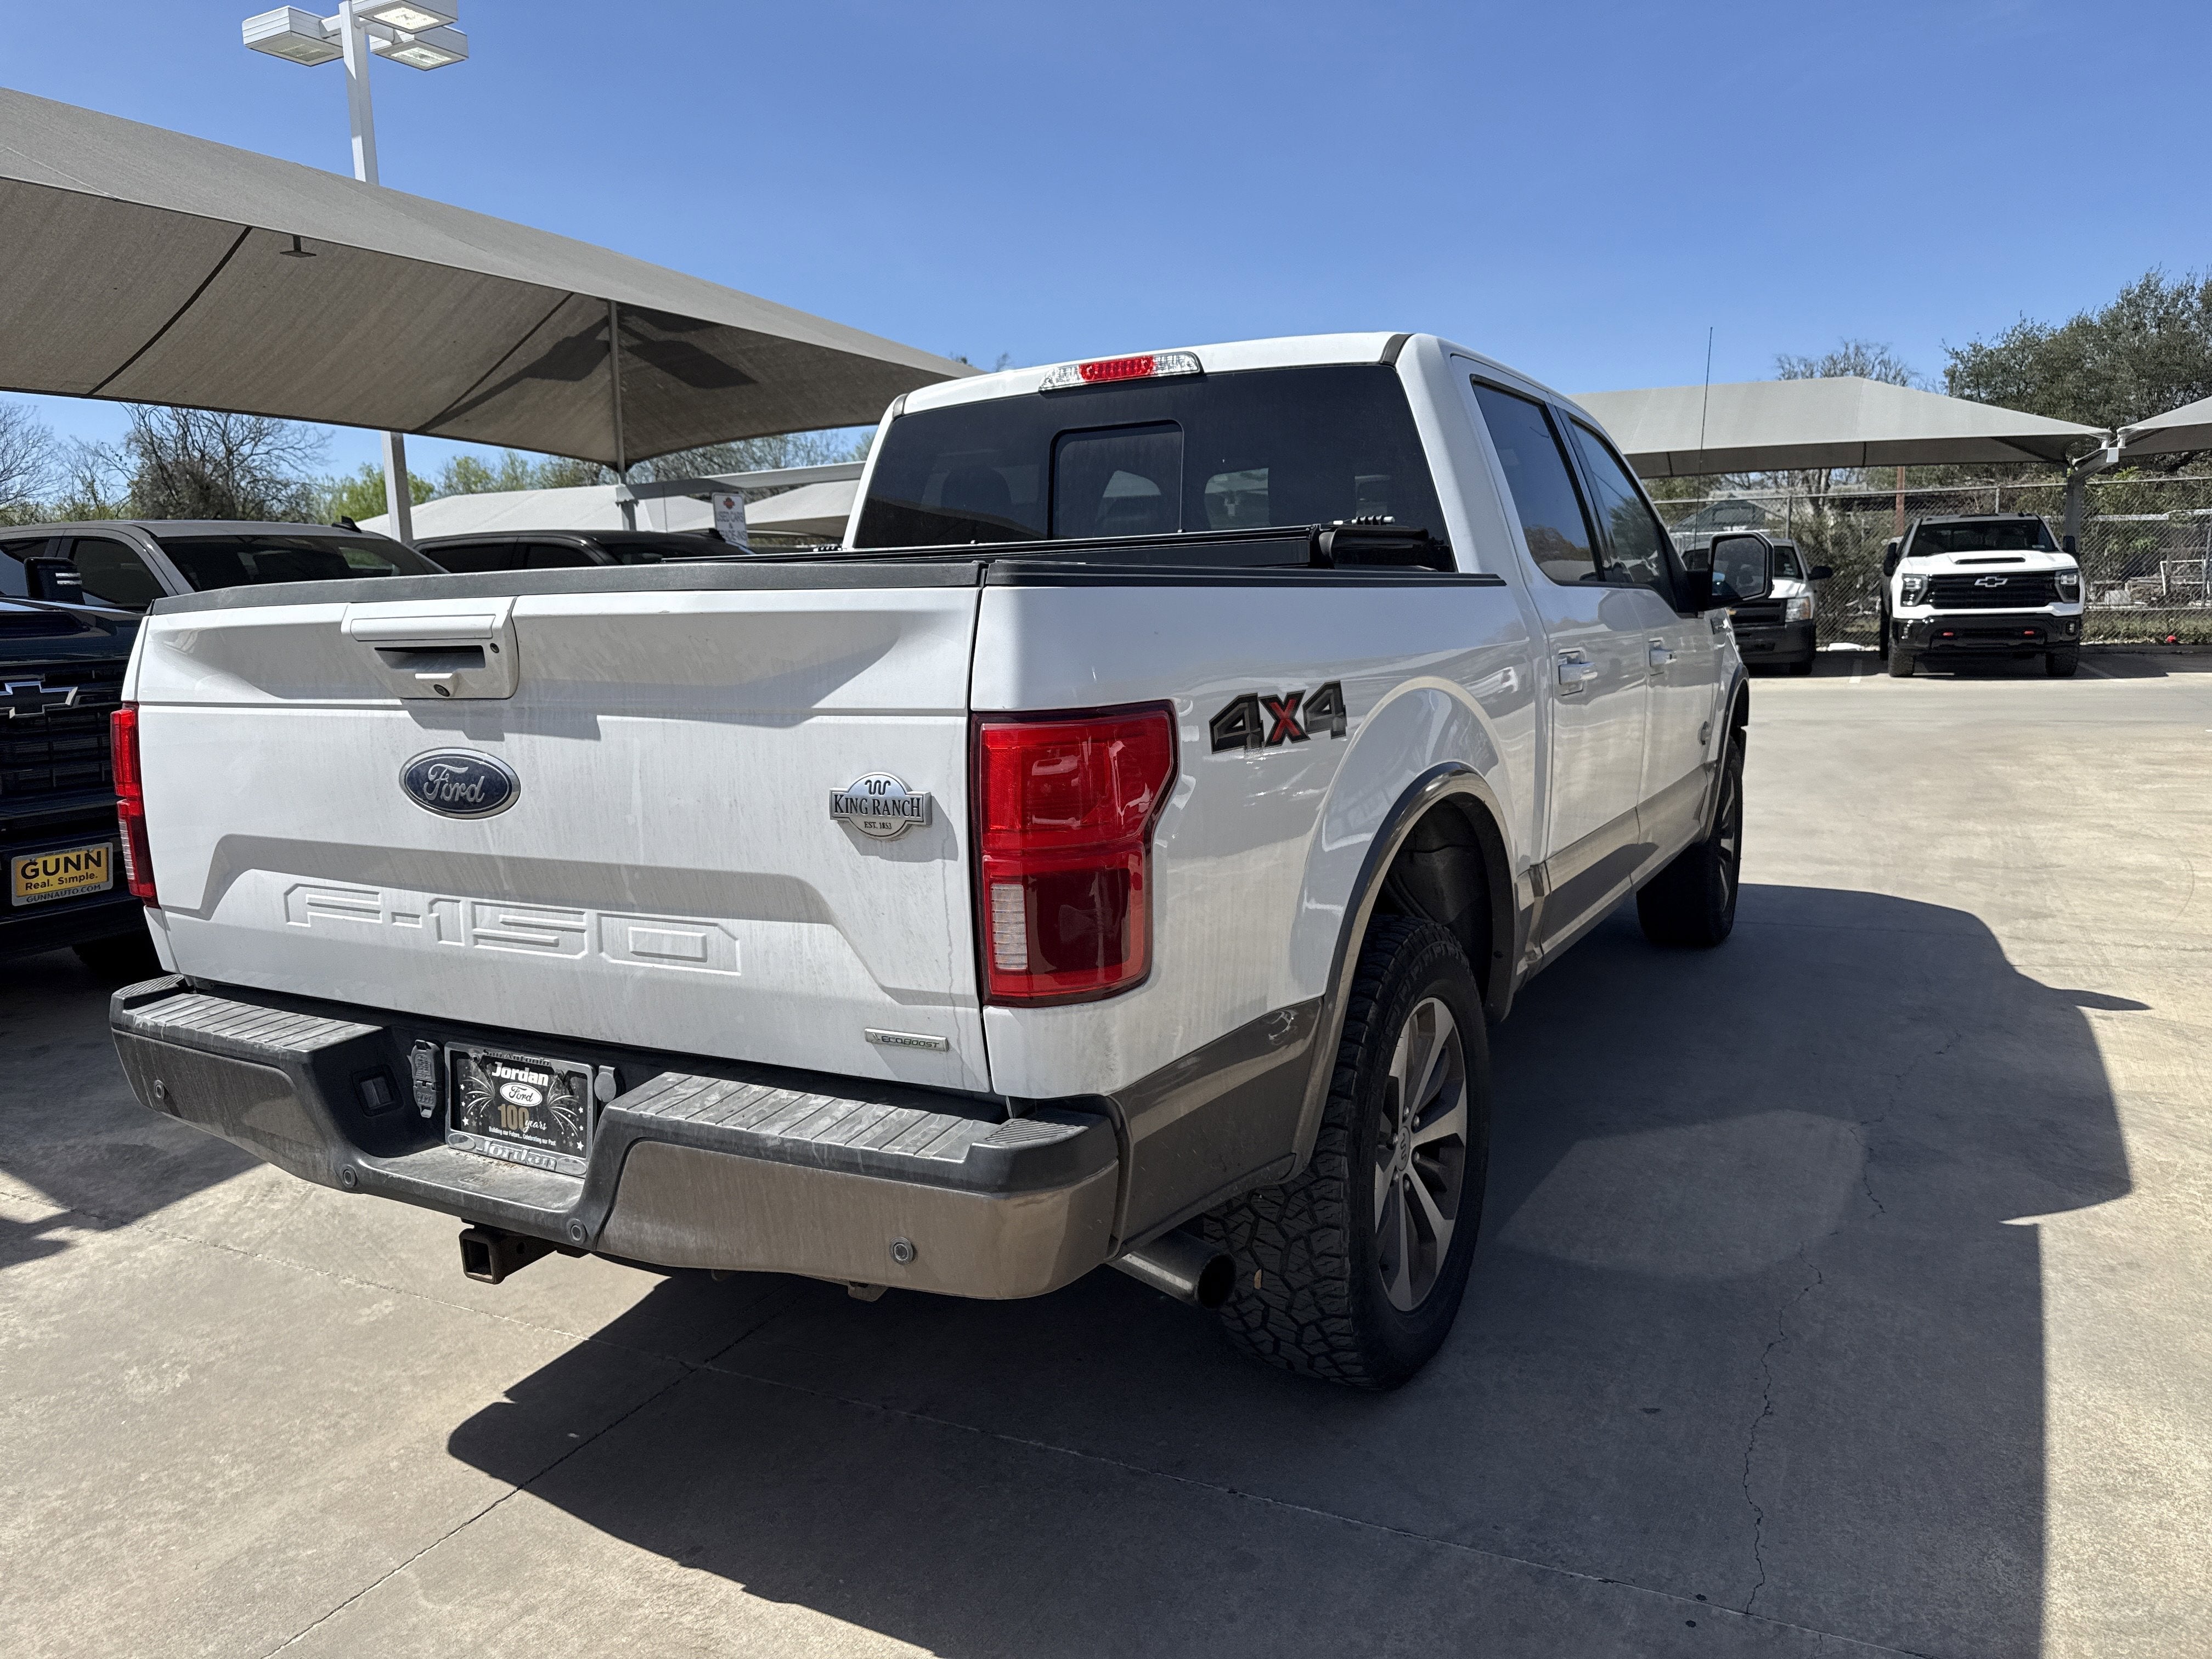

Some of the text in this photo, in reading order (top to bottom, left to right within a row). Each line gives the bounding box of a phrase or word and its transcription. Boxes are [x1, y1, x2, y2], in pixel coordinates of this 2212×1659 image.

[424, 763, 485, 803] Ford
[834, 794, 921, 817] KING RANCH
[21, 850, 102, 880] GUNN
[25, 872, 98, 891] Real. Simple.
[26, 883, 101, 903] GUNNAUTO.COM
[283, 883, 742, 976] F-150
[492, 1061, 549, 1086] Jordan
[509, 1086, 534, 1102] Ford
[497, 1103, 548, 1133] 100 years
[488, 1125, 503, 1136] Building
[522, 1133, 541, 1144] Celebrating
[548, 1138, 556, 1147] Past
[476, 1138, 557, 1171] Jordan
